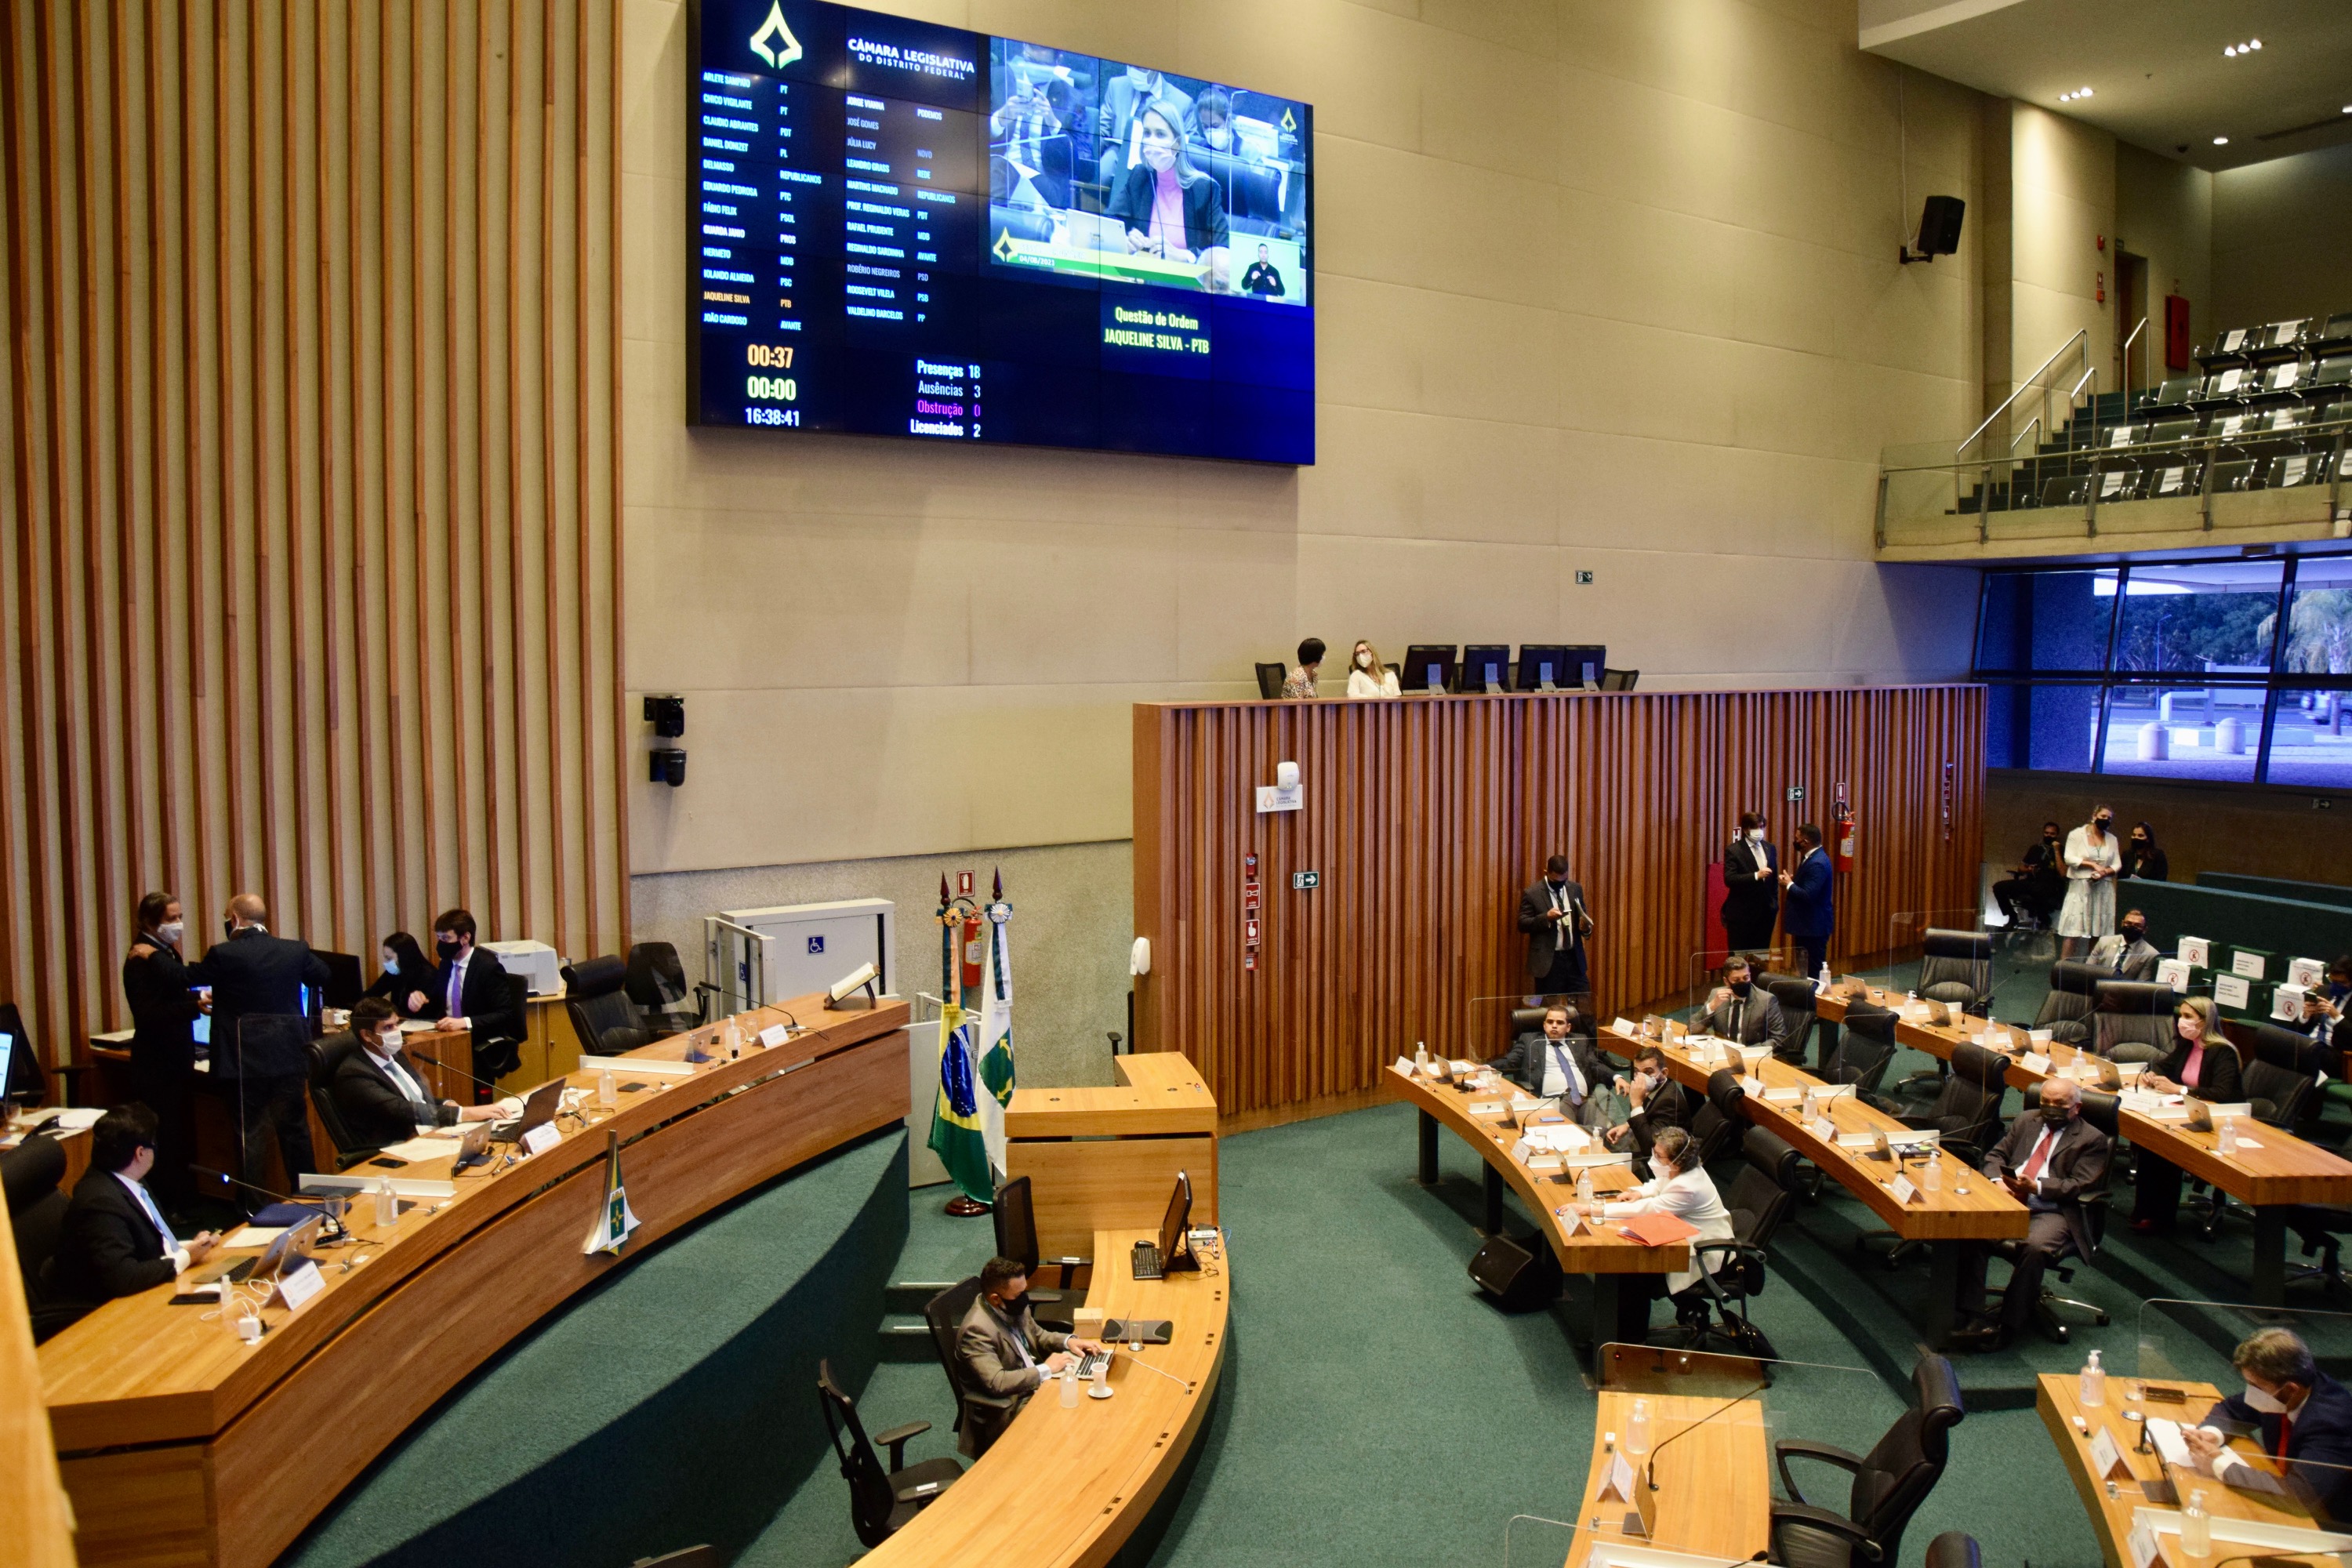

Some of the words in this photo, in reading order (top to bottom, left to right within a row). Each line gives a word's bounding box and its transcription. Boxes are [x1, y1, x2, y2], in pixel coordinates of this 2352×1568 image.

[848, 38, 899, 59] CÂMARA
[904, 49, 975, 73] LEGISLATIVA
[858, 53, 873, 63] DO
[877, 56, 920, 72] DISTRITO
[924, 65, 965, 81] FEDERAL
[703, 71, 724, 84] ARLETE
[779, 85, 788, 94] PT
[703, 93, 723, 105] CHICO
[724, 96, 753, 110] VIGILANTE
[847, 96, 864, 107] JORGE
[779, 105, 788, 115] PT
[917, 108, 942, 121] PODEMOS
[729, 119, 759, 132] ABRANTES
[847, 117, 860, 127] JOSÉ
[861, 119, 879, 130] GOMES
[779, 127, 792, 137] PDT
[703, 136, 724, 149] DANIEL
[724, 140, 749, 152] DONIZET
[847, 136, 862, 147] JÚLIA
[862, 140, 877, 150] LUCY
[779, 148, 788, 158] PL
[917, 149, 932, 158] NOVO
[703, 159, 735, 172] DELMASSO
[847, 158, 871, 171] LEANDRO
[872, 162, 890, 173] GRASS
[779, 169, 822, 184] REPUBLICANOS
[917, 169, 931, 180] REDE
[703, 180, 731, 193] EDUARDO
[731, 185, 757, 197] PEDROSA
[847, 180, 870, 191] MARTINS
[871, 183, 898, 196] MACHADO
[779, 191, 792, 201] PTC
[917, 190, 955, 204] REPUBLICANOS
[703, 201, 721, 213] FÁBIO
[721, 205, 737, 216] FELIX
[847, 201, 862, 212] PROF.
[862, 202, 892, 215] REGINALDO
[893, 207, 909, 218] VERAS
[917, 210, 928, 220] PDT
[780, 213, 795, 223] PSOL
[703, 224, 728, 237] GUARDA
[847, 221, 866, 233] RAFAEL
[867, 224, 894, 236] PRUDENTE
[780, 234, 796, 245] PROS
[917, 231, 930, 241] MDB
[703, 246, 731, 259] HERMETO
[847, 242, 877, 255] REGINALDO
[877, 246, 905, 258] SARDINHA
[780, 256, 794, 266] MDB
[917, 252, 937, 262] AVANTE
[703, 269, 729, 281] IOLANDO
[729, 272, 754, 283] ALMEIDA
[847, 263, 870, 274] ROBÉRIO
[871, 267, 900, 278] NEGREIROS
[918, 273, 928, 281] PSD
[780, 278, 792, 287] PSC
[703, 291, 733, 303] JAQUELINE
[734, 294, 750, 304] SILVA
[847, 285, 877, 296] ROOSEVELT
[877, 289, 895, 298] VILELA
[917, 293, 928, 303] PSB
[780, 299, 791, 308] PTB
[703, 312, 718, 323] JOÃO
[719, 314, 747, 326] CARDOSO
[847, 306, 876, 318] VALDELINO
[876, 309, 903, 320] BARCELOS
[918, 314, 925, 322] PP
[1115, 306, 1153, 323] Questão
[1155, 312, 1167, 326] de
[1169, 313, 1198, 330] Ordem
[780, 320, 801, 331] AVANTE
[1104, 328, 1154, 347] JAQUELINE
[1156, 334, 1183, 350] SILVA
[1191, 339, 1210, 354] PTB
[748, 344, 793, 368] 00:37
[917, 359, 964, 379] Presenças
[969, 365, 981, 379] 18
[747, 376, 797, 401] 00:00
[918, 380, 964, 397] Ausências
[974, 385, 981, 398] 3
[917, 399, 964, 418] Obstrução
[974, 405, 981, 417] 0
[745, 407, 800, 426] 16:38:41
[910, 419, 964, 437] Licenciados
[973, 423, 981, 437] 2
